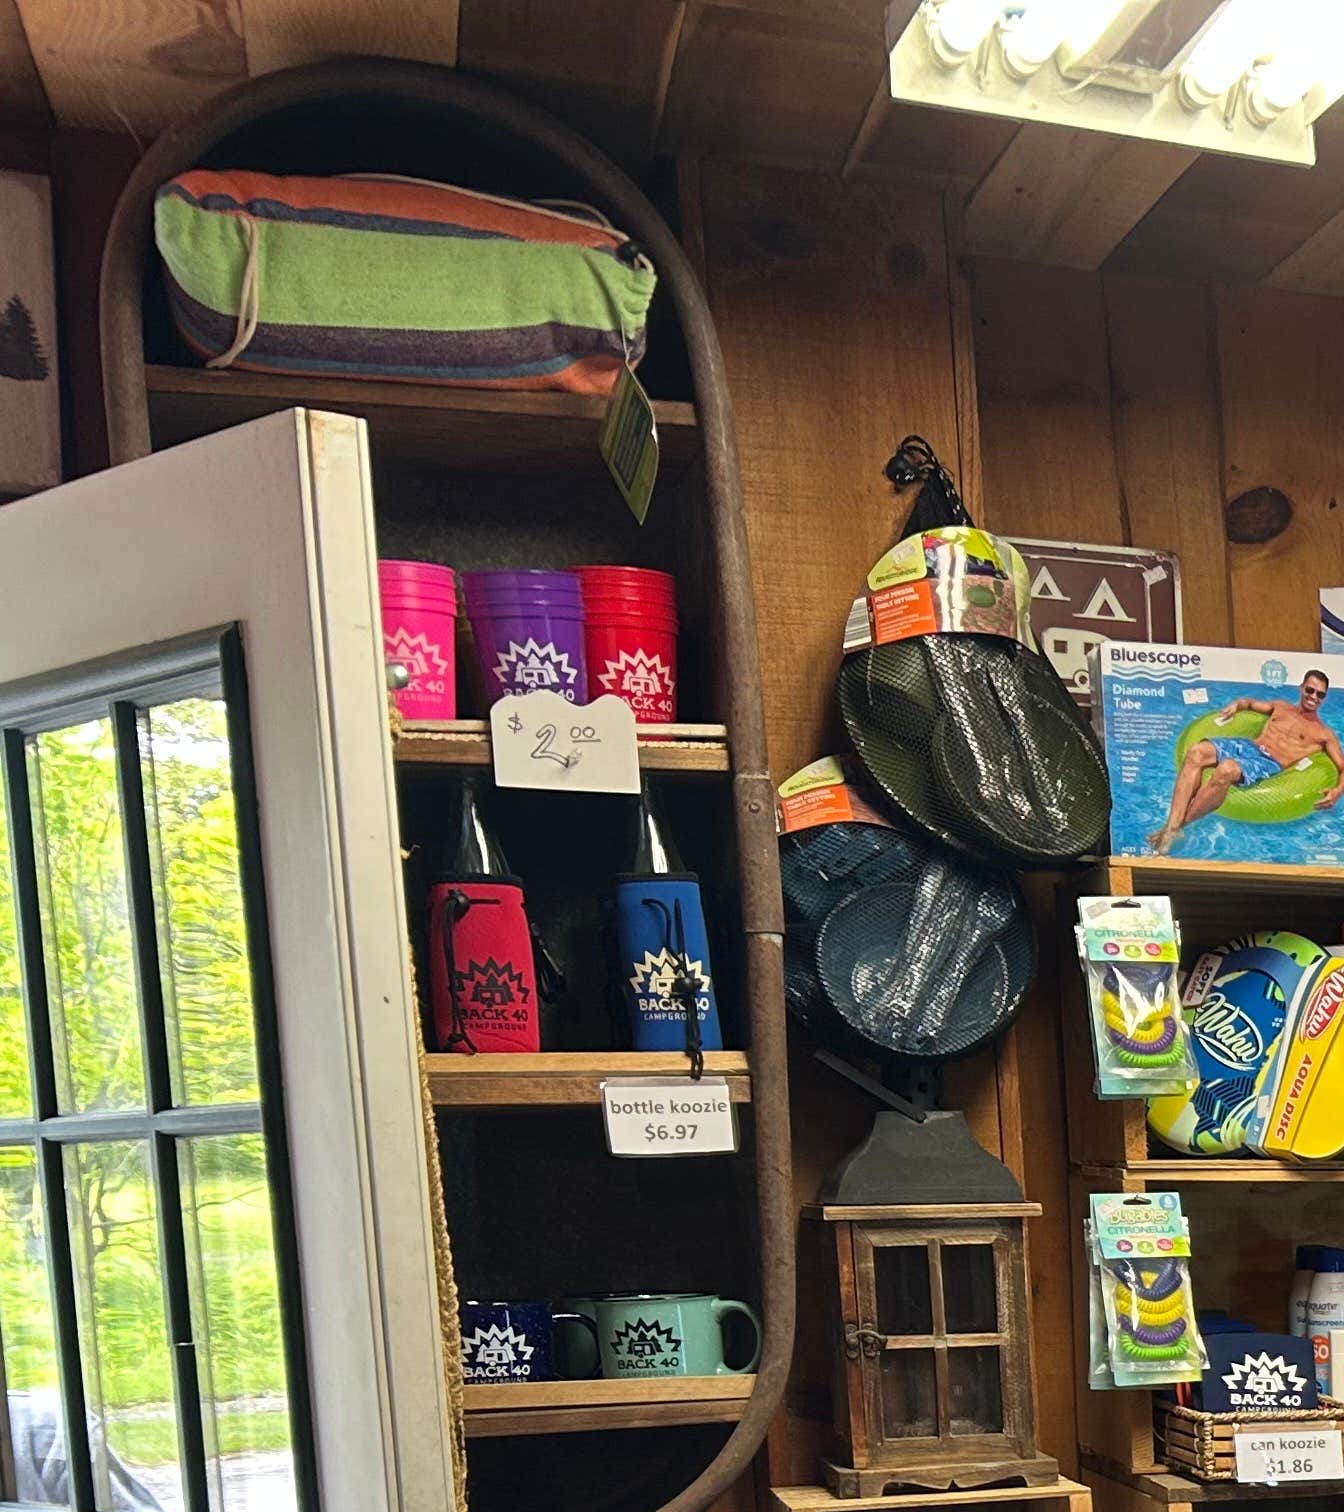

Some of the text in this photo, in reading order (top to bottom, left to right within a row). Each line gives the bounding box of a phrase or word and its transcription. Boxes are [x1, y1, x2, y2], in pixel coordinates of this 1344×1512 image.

[1111, 649, 1200, 668] Bluescape
[1113, 685, 1165, 698] Diamond
[1114, 699, 1141, 710] Tube
[512, 1009, 528, 1022] 40
[1195, 992, 1258, 1062] Wahu
[1276, 1054, 1313, 1143] AQUA DISC
[611, 1100, 727, 1114] bottle koozie
[645, 1125, 698, 1140] $6.97
[1108, 1226, 1175, 1235] CITRONELLA
[618, 1358, 679, 1370] BACK 40
[463, 1365, 530, 1377] BACK 40
[1230, 1394, 1301, 1406] BACK 40
[1251, 1436, 1326, 1452] can koozie
[1267, 1458, 1313, 1475] $1.86
